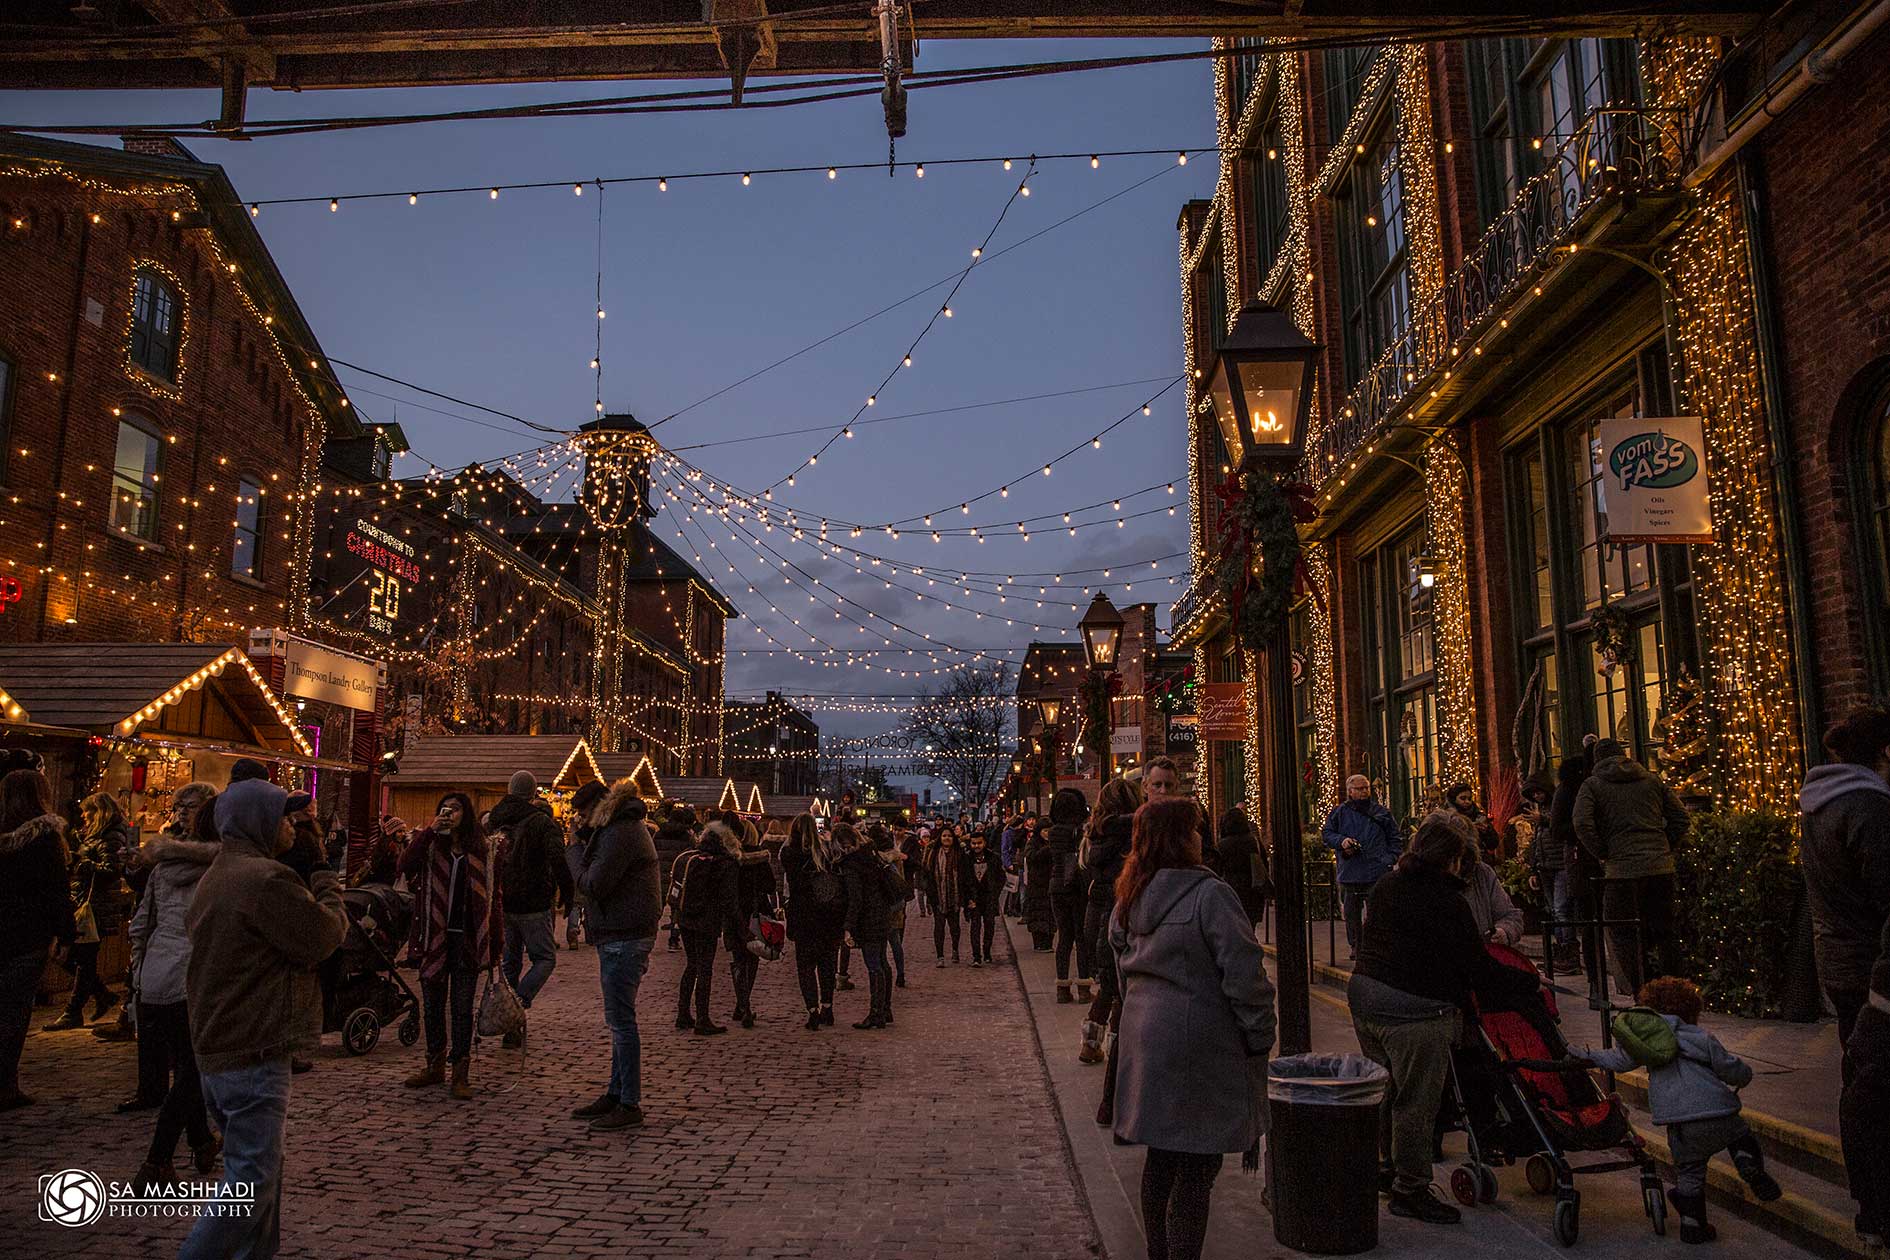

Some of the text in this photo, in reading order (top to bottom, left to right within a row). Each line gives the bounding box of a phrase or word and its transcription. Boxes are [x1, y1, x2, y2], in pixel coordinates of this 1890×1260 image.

[1617, 440, 1651, 464] vom
[1620, 441, 1685, 490] FASS
[357, 519, 414, 557] COUNTDOWN TO
[346, 531, 420, 584] CHRISTMAS
[369, 568, 400, 620] 20
[369, 613, 392, 635] DAYS
[290, 661, 373, 696] Thompson Landry Gallery
[1169, 733, 1194, 742] (416)
